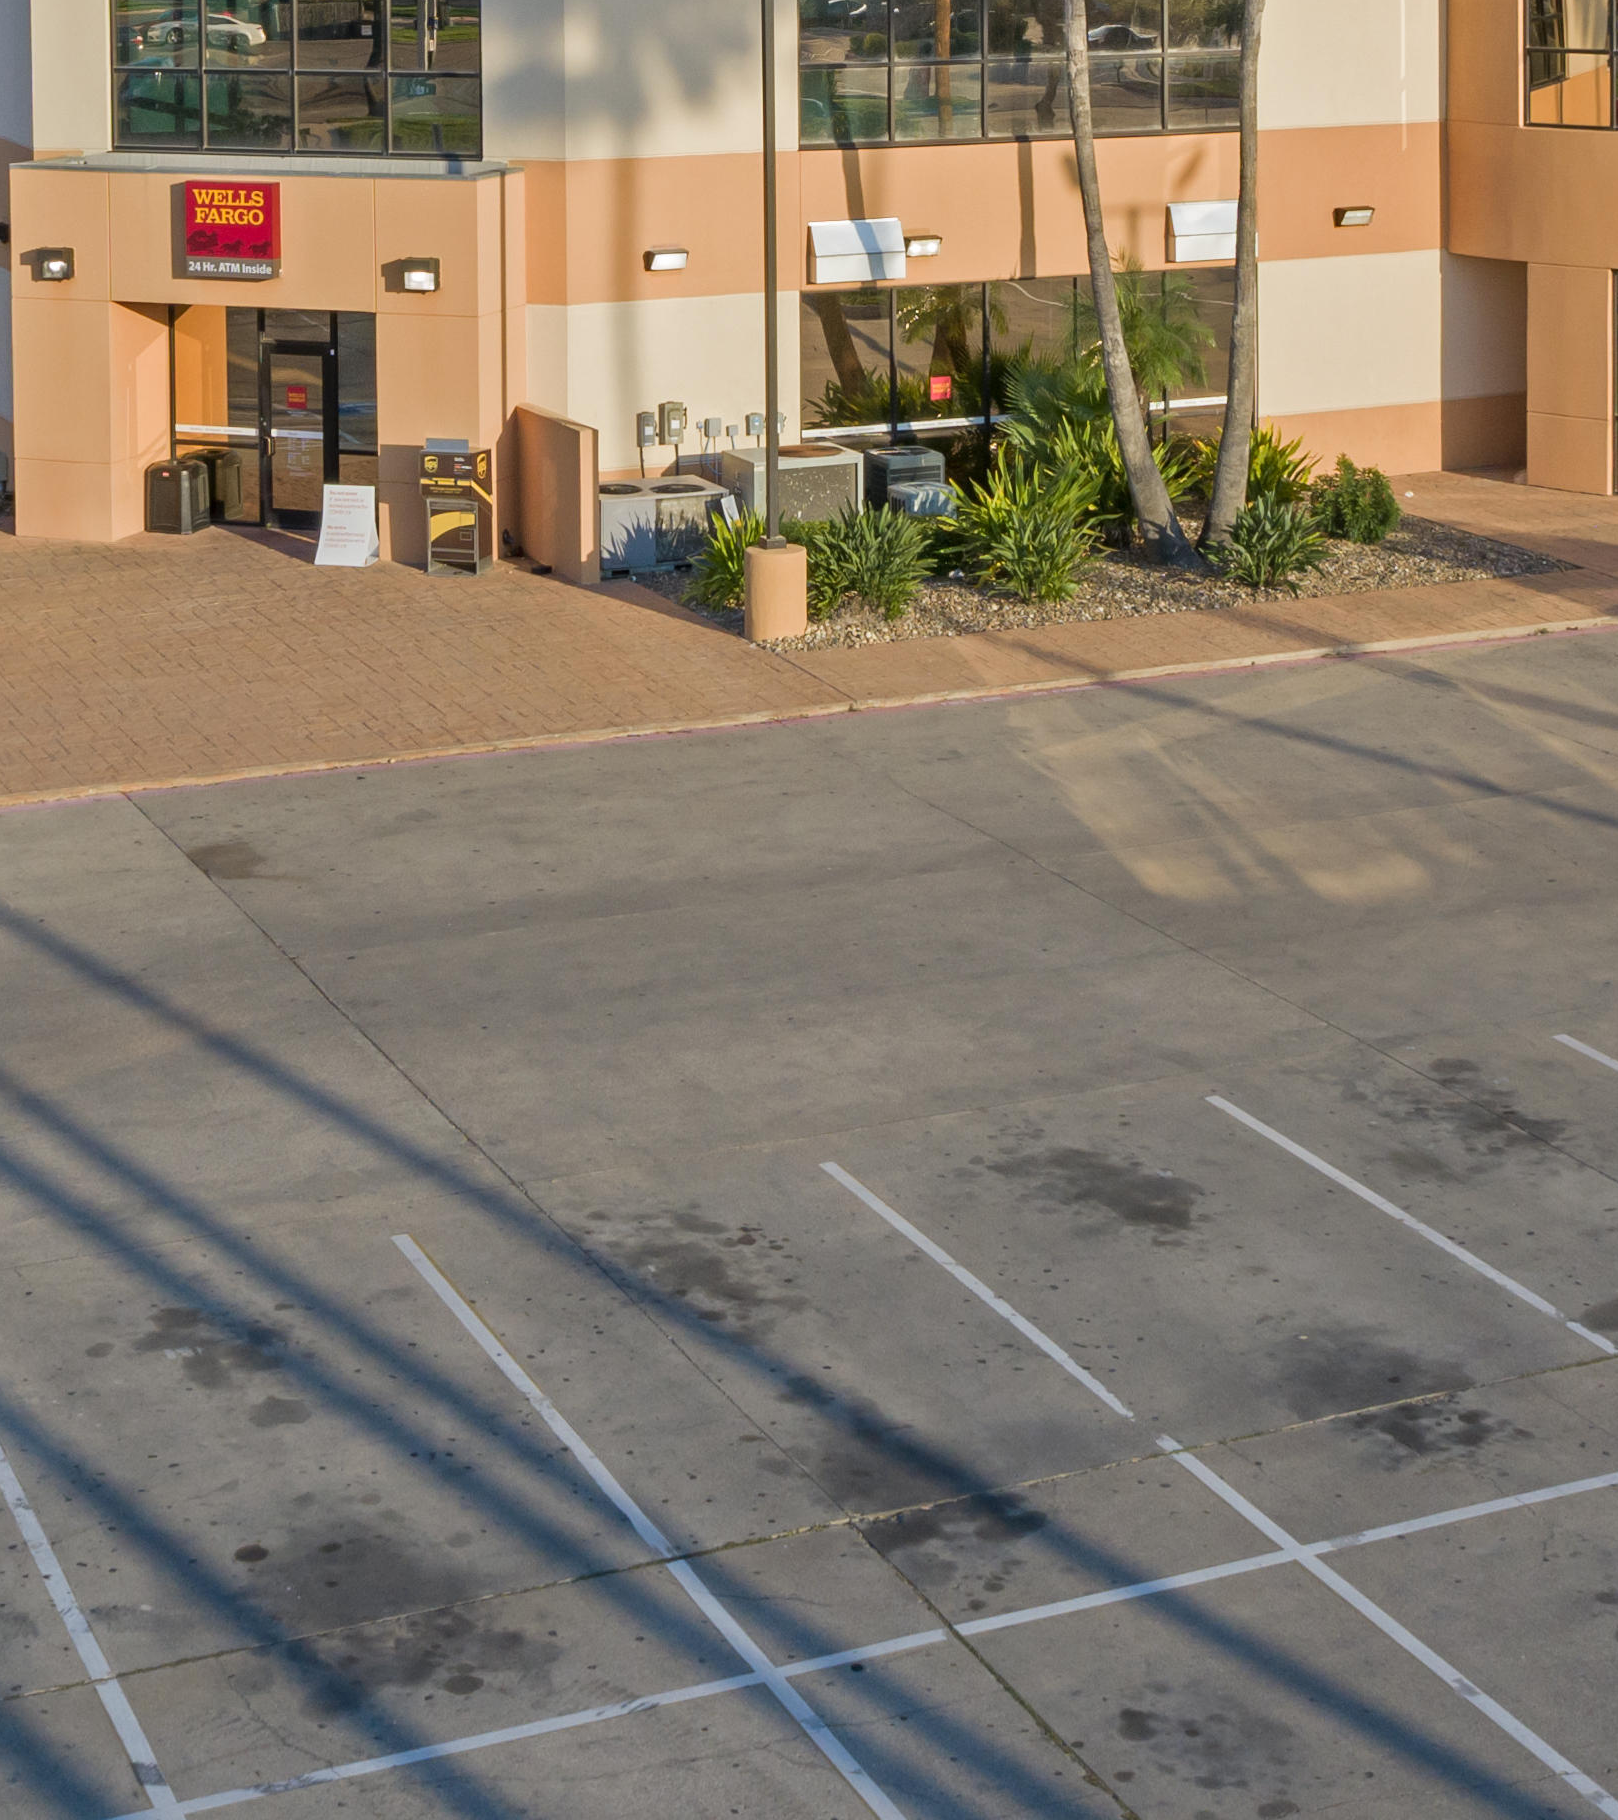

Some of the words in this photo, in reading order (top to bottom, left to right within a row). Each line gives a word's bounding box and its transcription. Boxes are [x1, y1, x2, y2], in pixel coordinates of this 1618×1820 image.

[192, 188, 264, 207] WELLS
[195, 207, 264, 225] FARGO
[188, 261, 201, 272] 24
[202, 262, 217, 272] Hr.
[218, 263, 240, 273] ATM
[242, 263, 273, 275] Inside
